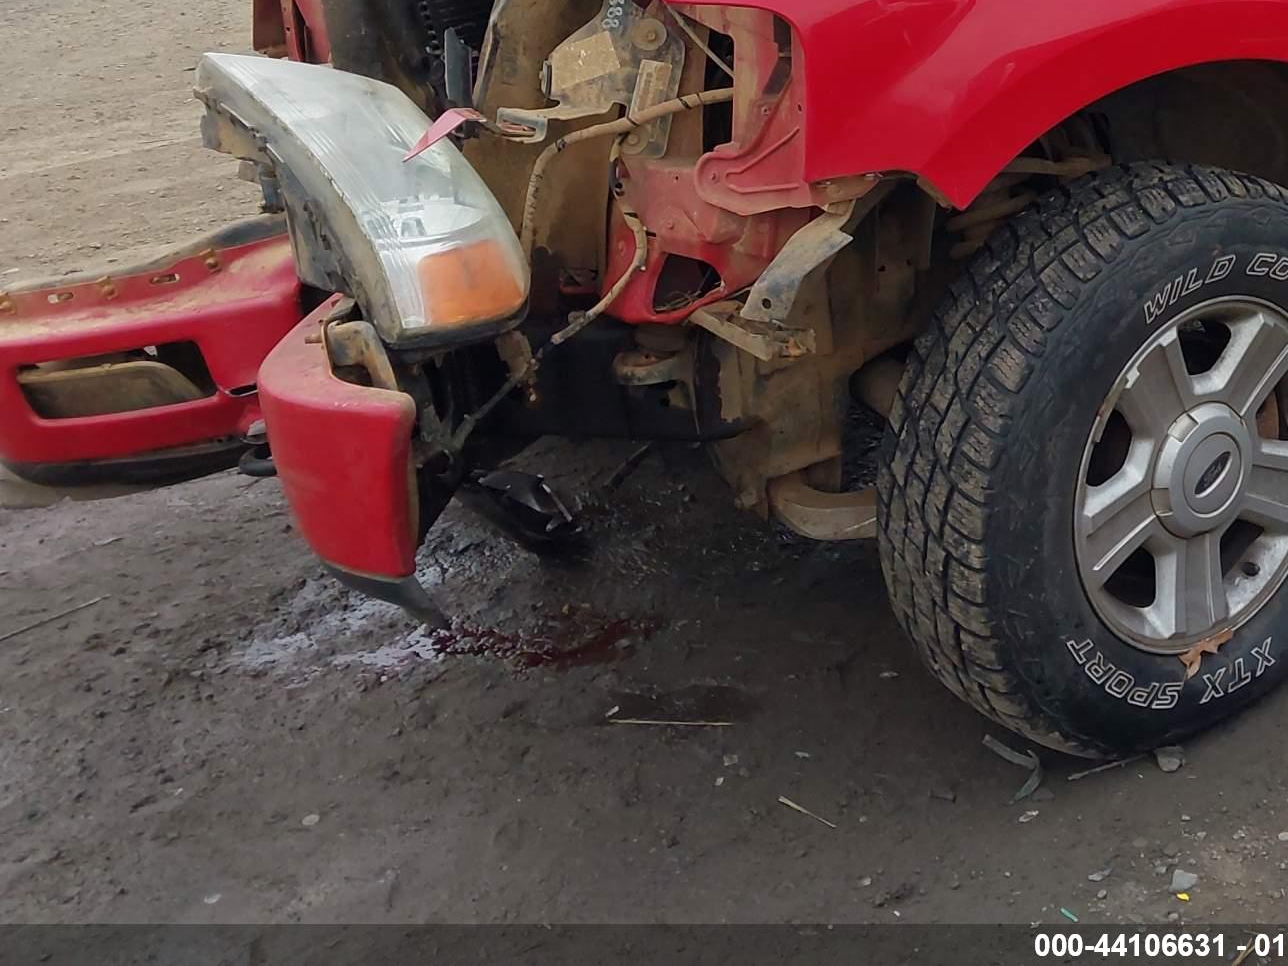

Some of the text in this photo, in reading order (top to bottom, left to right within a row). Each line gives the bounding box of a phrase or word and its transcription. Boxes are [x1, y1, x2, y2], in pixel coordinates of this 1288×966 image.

[1143, 254, 1236, 325] WILD
[1066, 637, 1276, 709] XTX SPORT
